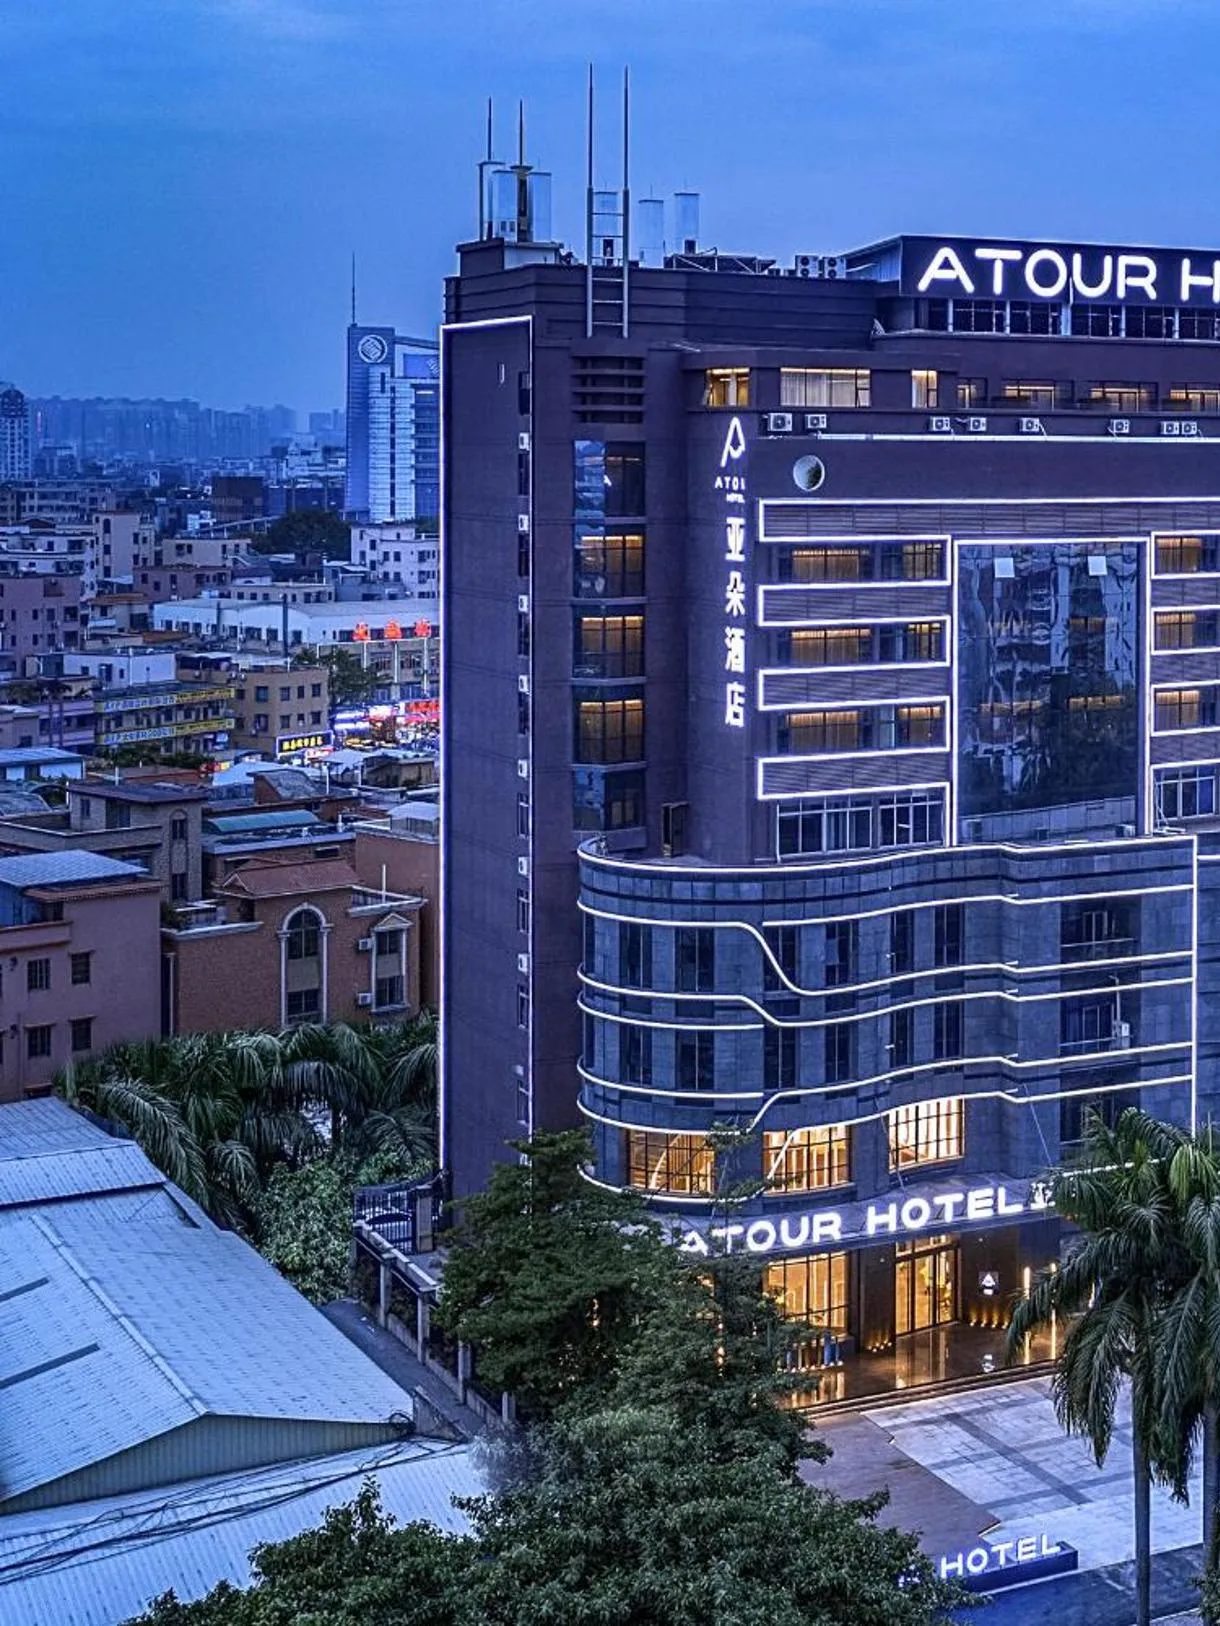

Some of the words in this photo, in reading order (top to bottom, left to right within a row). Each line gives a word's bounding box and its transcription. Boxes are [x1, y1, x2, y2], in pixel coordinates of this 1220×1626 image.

[917, 246, 1157, 300] ATOUR
[725, 516, 746, 728] 亚朵酒店
[679, 1211, 842, 1256] ATOUR
[866, 1186, 1024, 1235] HOTEL
[940, 1533, 1062, 1579] HOTEL
